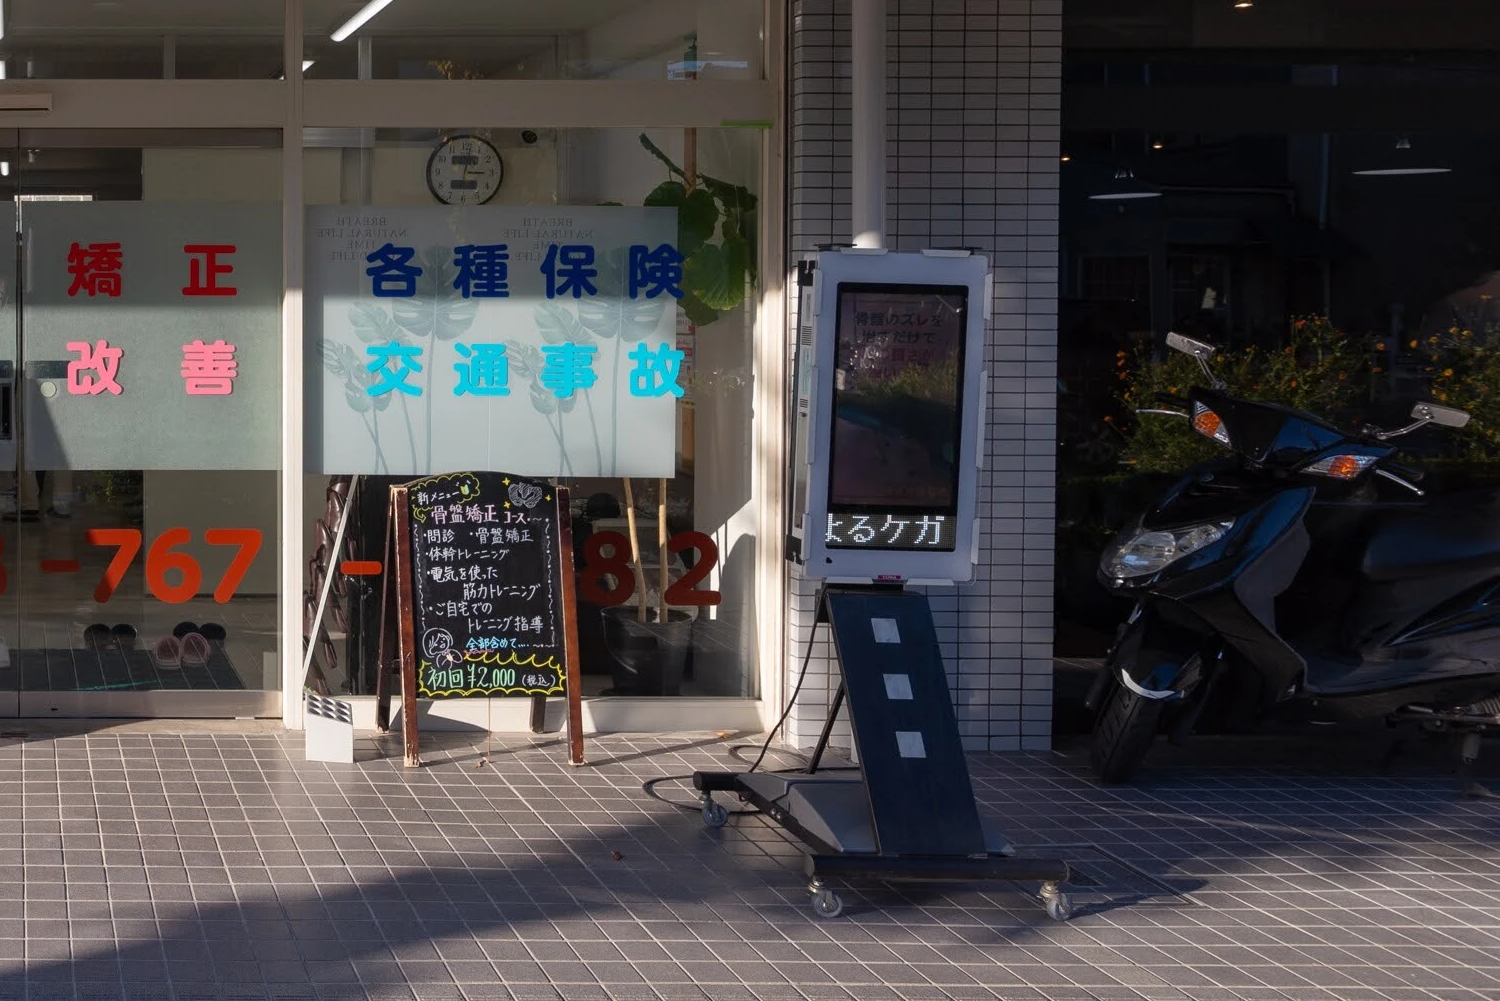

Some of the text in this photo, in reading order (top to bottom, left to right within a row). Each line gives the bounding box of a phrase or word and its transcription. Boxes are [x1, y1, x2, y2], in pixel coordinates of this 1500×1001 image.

[366, 242, 685, 299] 各種保険
[366, 342, 685, 398] 交通事故
[417, 490, 460, 506] 新メニュー
[463, 583, 541, 601] 筋力トレーニング
[468, 615, 544, 634] トレーニング指導
